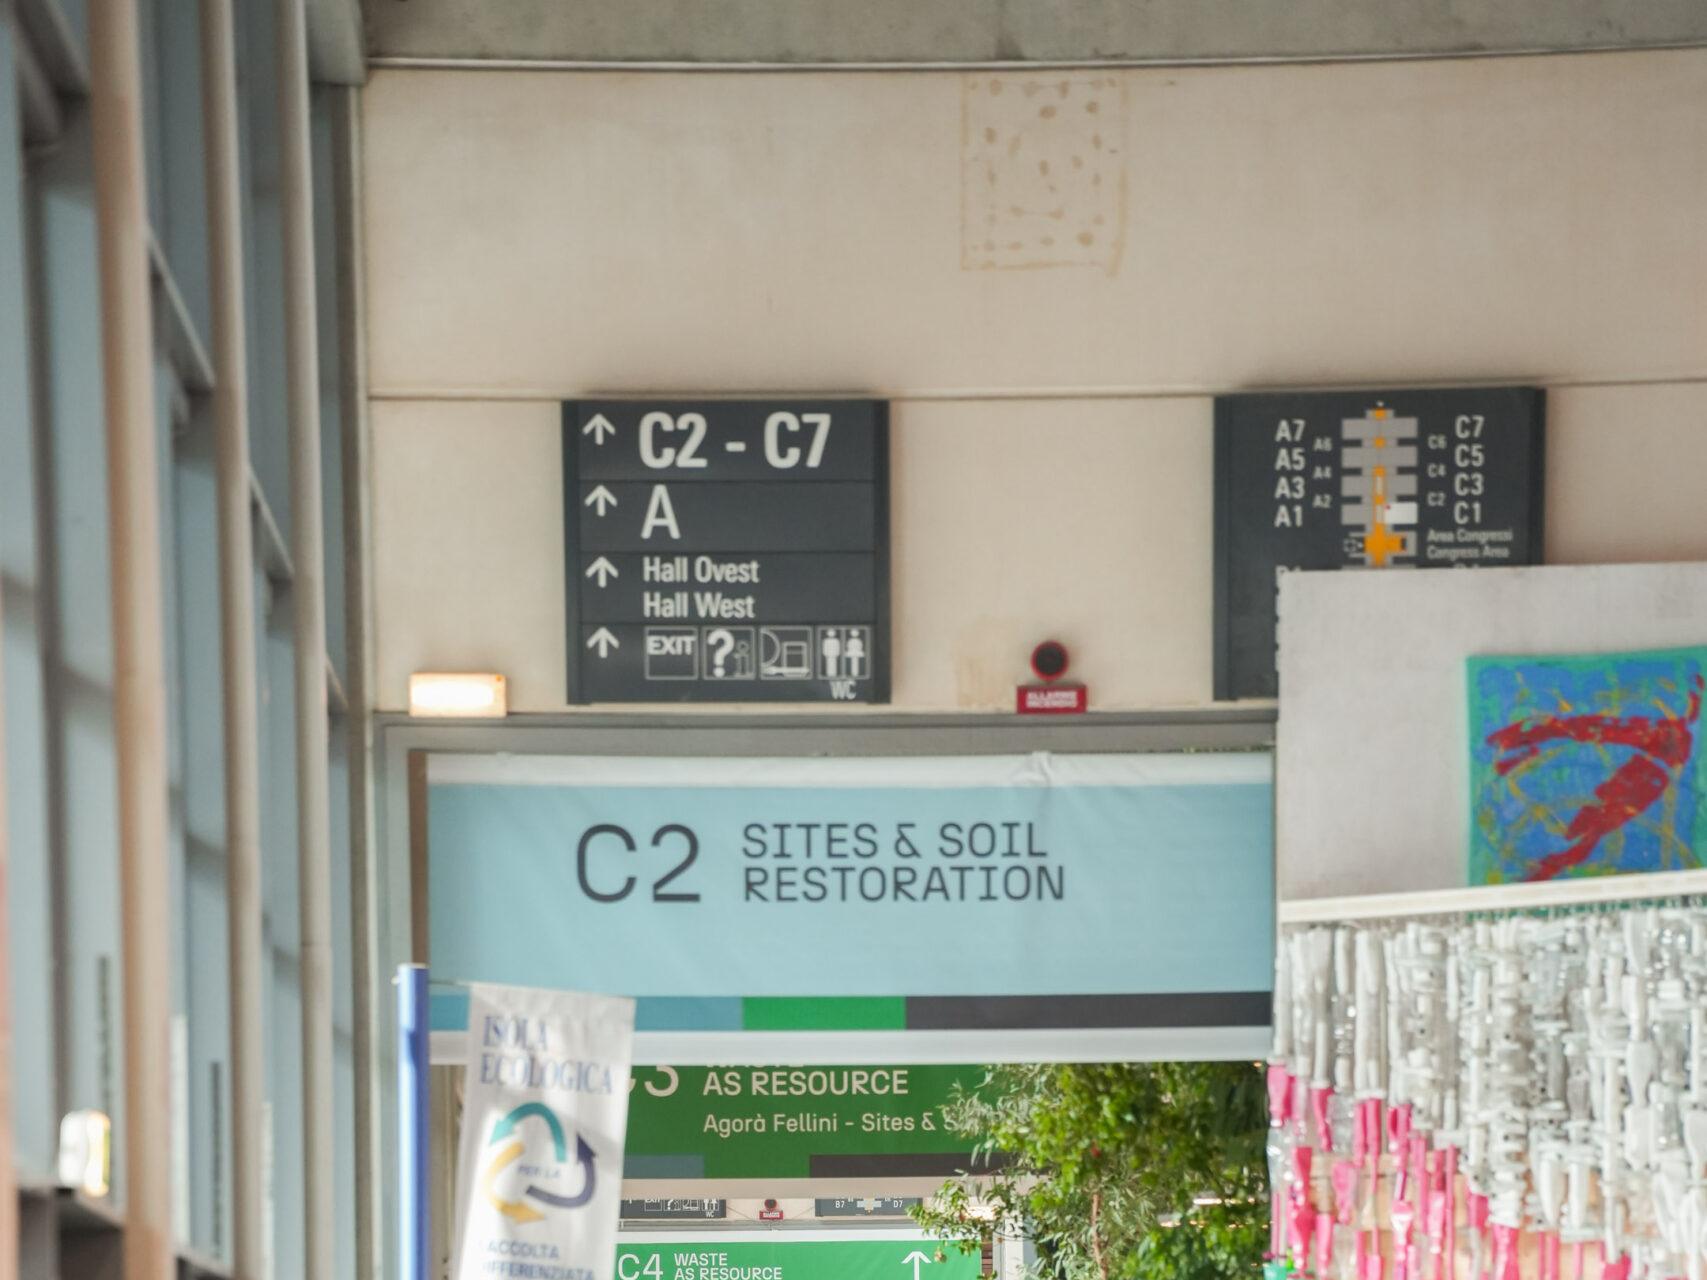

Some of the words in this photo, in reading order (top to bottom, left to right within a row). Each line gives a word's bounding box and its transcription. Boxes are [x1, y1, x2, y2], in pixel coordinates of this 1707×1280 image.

[1275, 419, 1306, 442] A7
[1455, 415, 1484, 438] C7
[639, 411, 708, 469] C2
[764, 411, 832, 469] C7
[1275, 447, 1306, 471] A5
[1455, 444, 1484, 467] C5
[1313, 466, 1332, 480] A4
[1428, 464, 1446, 478] C4
[1275, 476, 1306, 499] A3
[1455, 473, 1484, 496] C3
[1312, 494, 1332, 508] A2
[1427, 492, 1446, 507] C2
[641, 484, 681, 539] A
[1274, 504, 1304, 528] A1
[1454, 501, 1481, 525] C1
[643, 556, 688, 583] Hall
[695, 556, 760, 583] Ovest
[643, 592, 688, 618] Hall
[695, 592, 756, 618] West
[647, 635, 696, 655] EXIT
[830, 680, 857, 700] WC
[743, 823, 878, 859] SITES
[894, 823, 922, 859] &
[939, 822, 1047, 859] SOIL
[577, 823, 701, 903] C2
[744, 865, 1064, 902] RESTORATION
[703, 1071, 742, 1096] AS
[751, 1070, 908, 1096] RESOURCE
[704, 1113, 766, 1138] Agorà
[773, 1113, 837, 1132] Fellini
[861, 1112, 914, 1132] Sites
[921, 1112, 936, 1131] &
[618, 1253, 663, 1280] C4
[674, 1253, 727, 1266] WASTE
[674, 1267, 695, 1280] AS
[700, 1267, 782, 1280] RESOURCE
